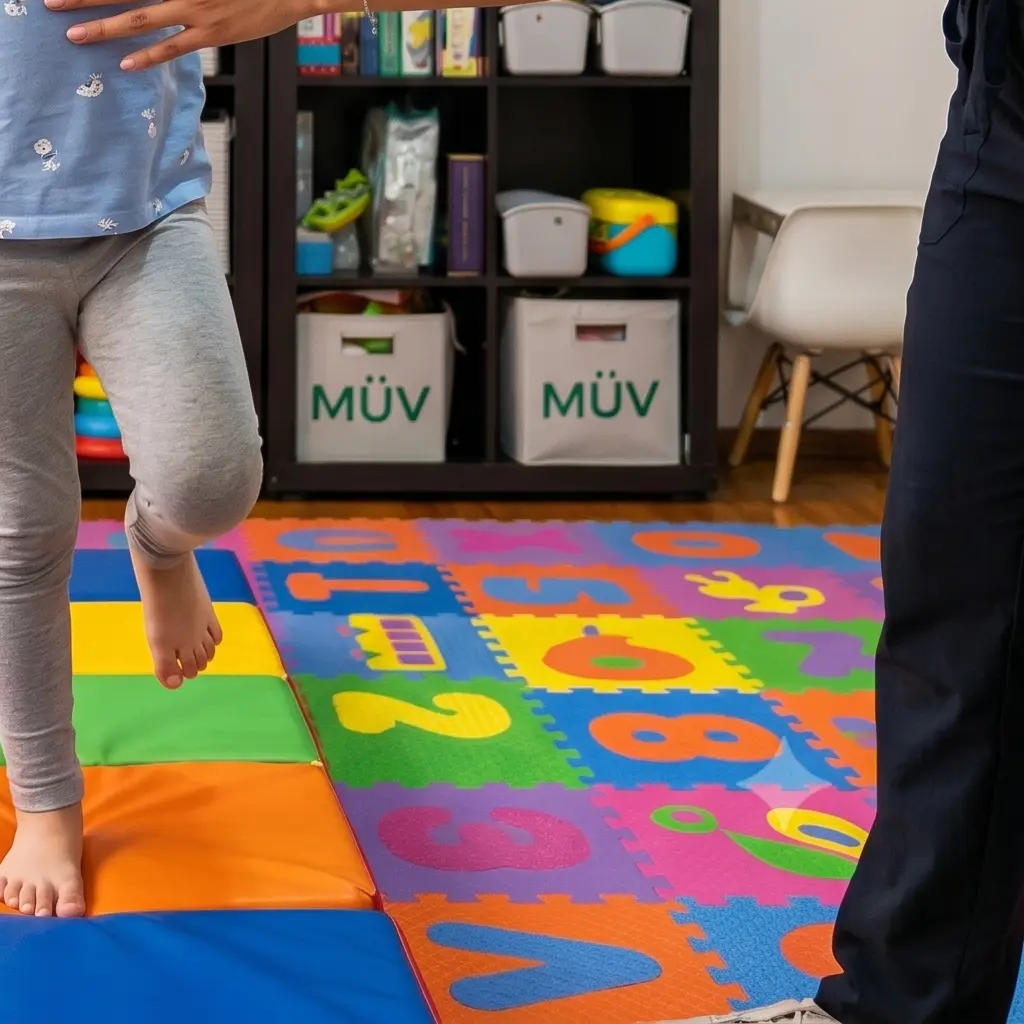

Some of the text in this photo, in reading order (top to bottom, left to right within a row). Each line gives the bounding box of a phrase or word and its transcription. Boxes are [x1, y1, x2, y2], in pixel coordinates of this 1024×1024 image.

[311, 376, 431, 422] MÜV
[542, 370, 659, 420] MÜV
[332, 691, 511, 739] 2
[589, 713, 782, 762] 8
[378, 805, 591, 873] 3
